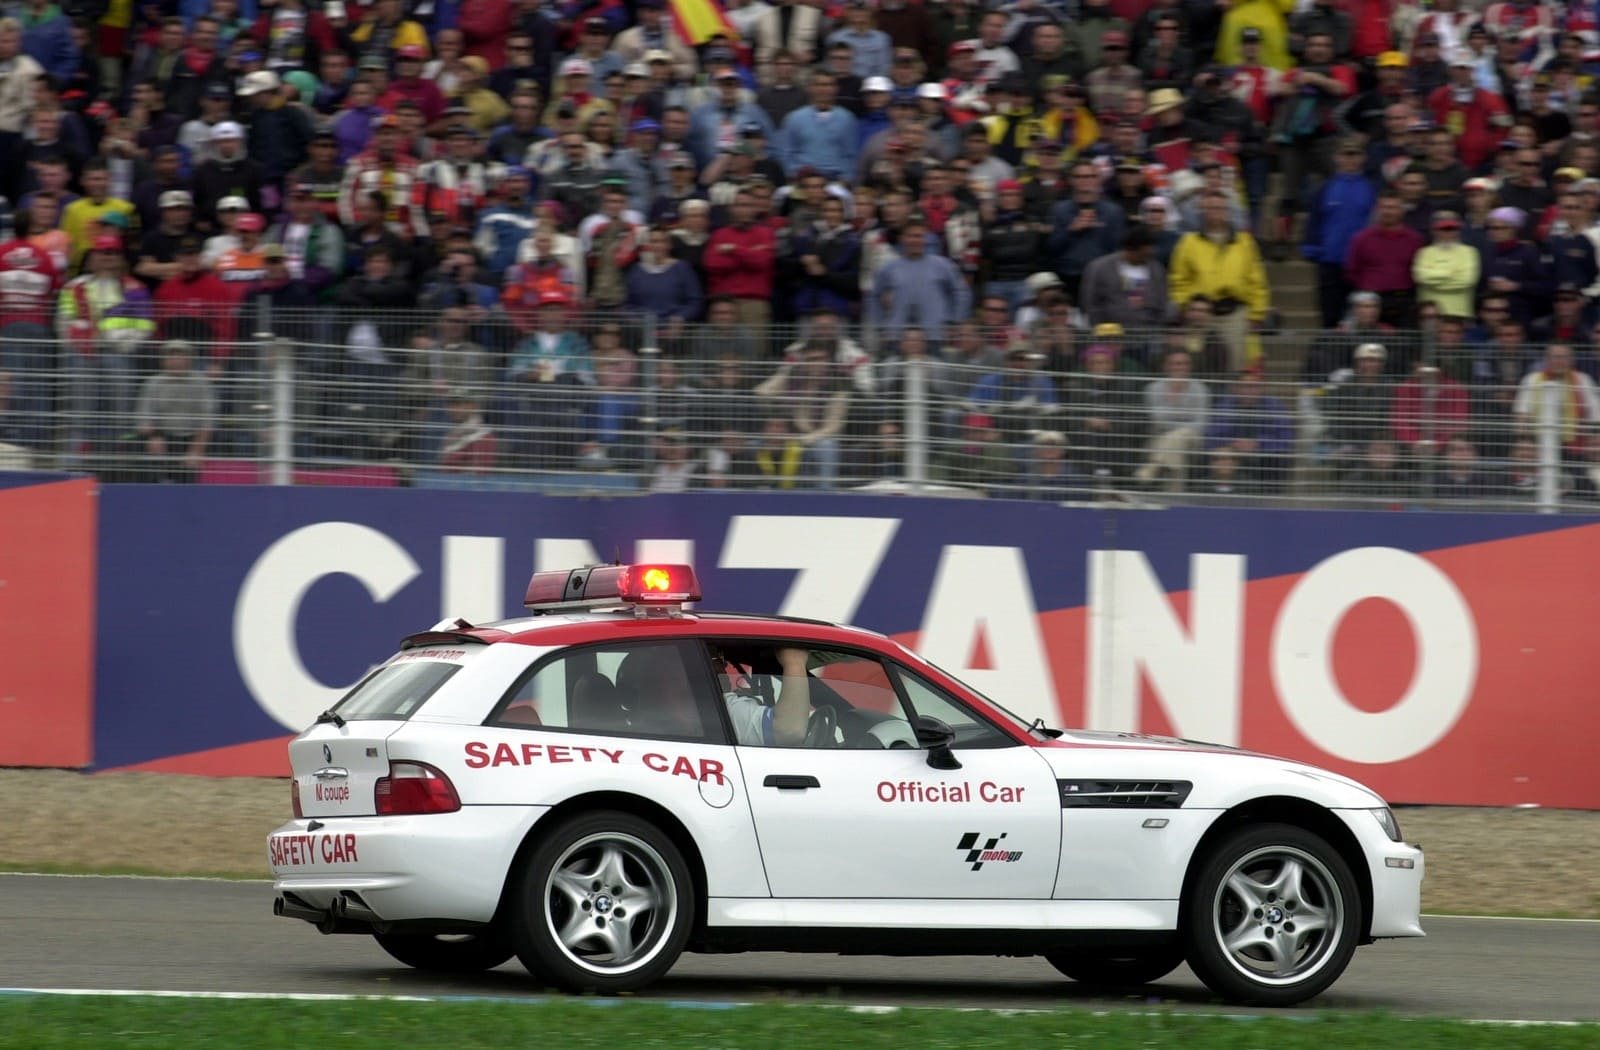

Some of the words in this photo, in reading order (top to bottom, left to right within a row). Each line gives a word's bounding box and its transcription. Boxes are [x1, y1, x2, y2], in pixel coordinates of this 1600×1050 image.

[233, 515, 1480, 764] CZANO
[464, 741, 624, 769] SAFETY
[642, 752, 725, 786] CAR
[324, 782, 349, 805] coupé
[876, 781, 970, 803] Official
[979, 781, 1026, 803] Car
[270, 835, 316, 866] SAFETY
[321, 833, 358, 864] CAR
